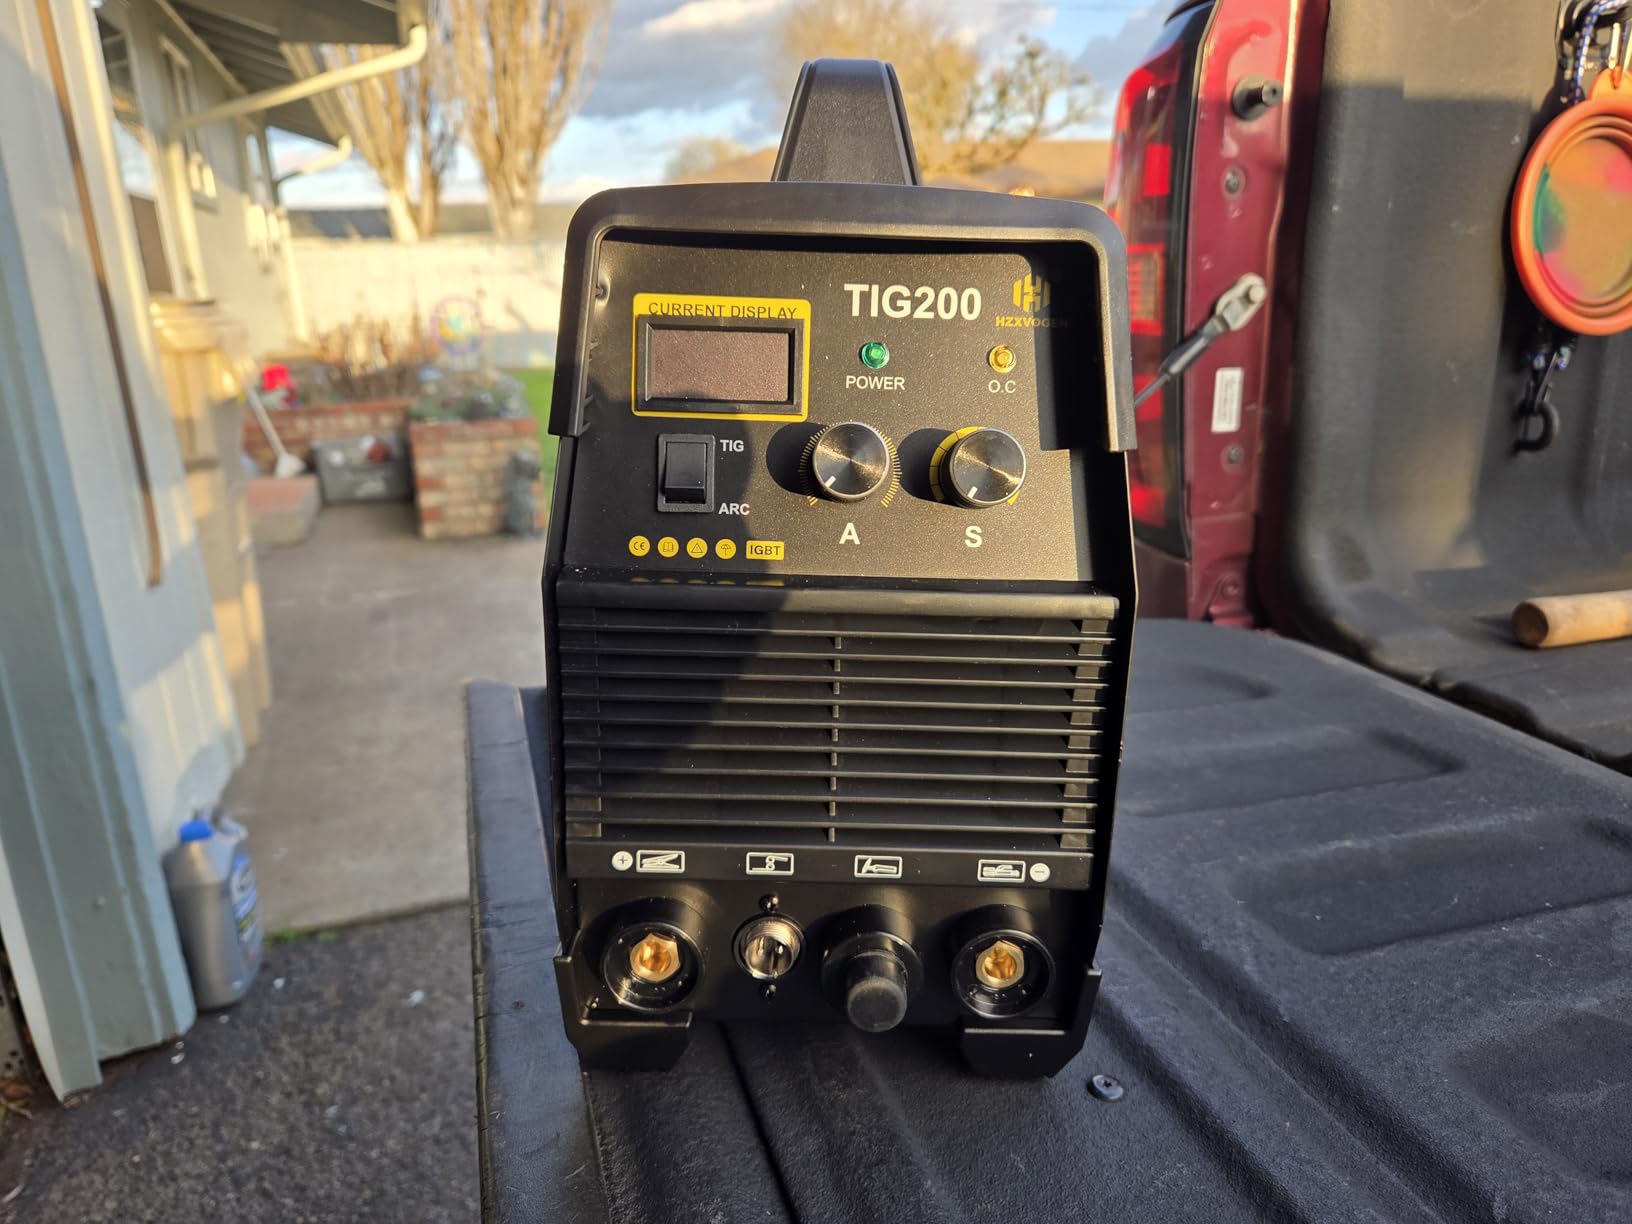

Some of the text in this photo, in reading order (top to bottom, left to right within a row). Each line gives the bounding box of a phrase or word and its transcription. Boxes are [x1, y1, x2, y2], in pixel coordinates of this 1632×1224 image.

[844, 283, 982, 320] TIG200
[648, 302, 797, 320] CURRENT DISPLAY
[845, 375, 905, 391] POWER
[988, 379, 1016, 394] O.C
[720, 439, 744, 452] TIG
[718, 502, 750, 516] ARC
[839, 522, 860, 545] A
[964, 525, 983, 548] S
[750, 545, 781, 556] IGBT
